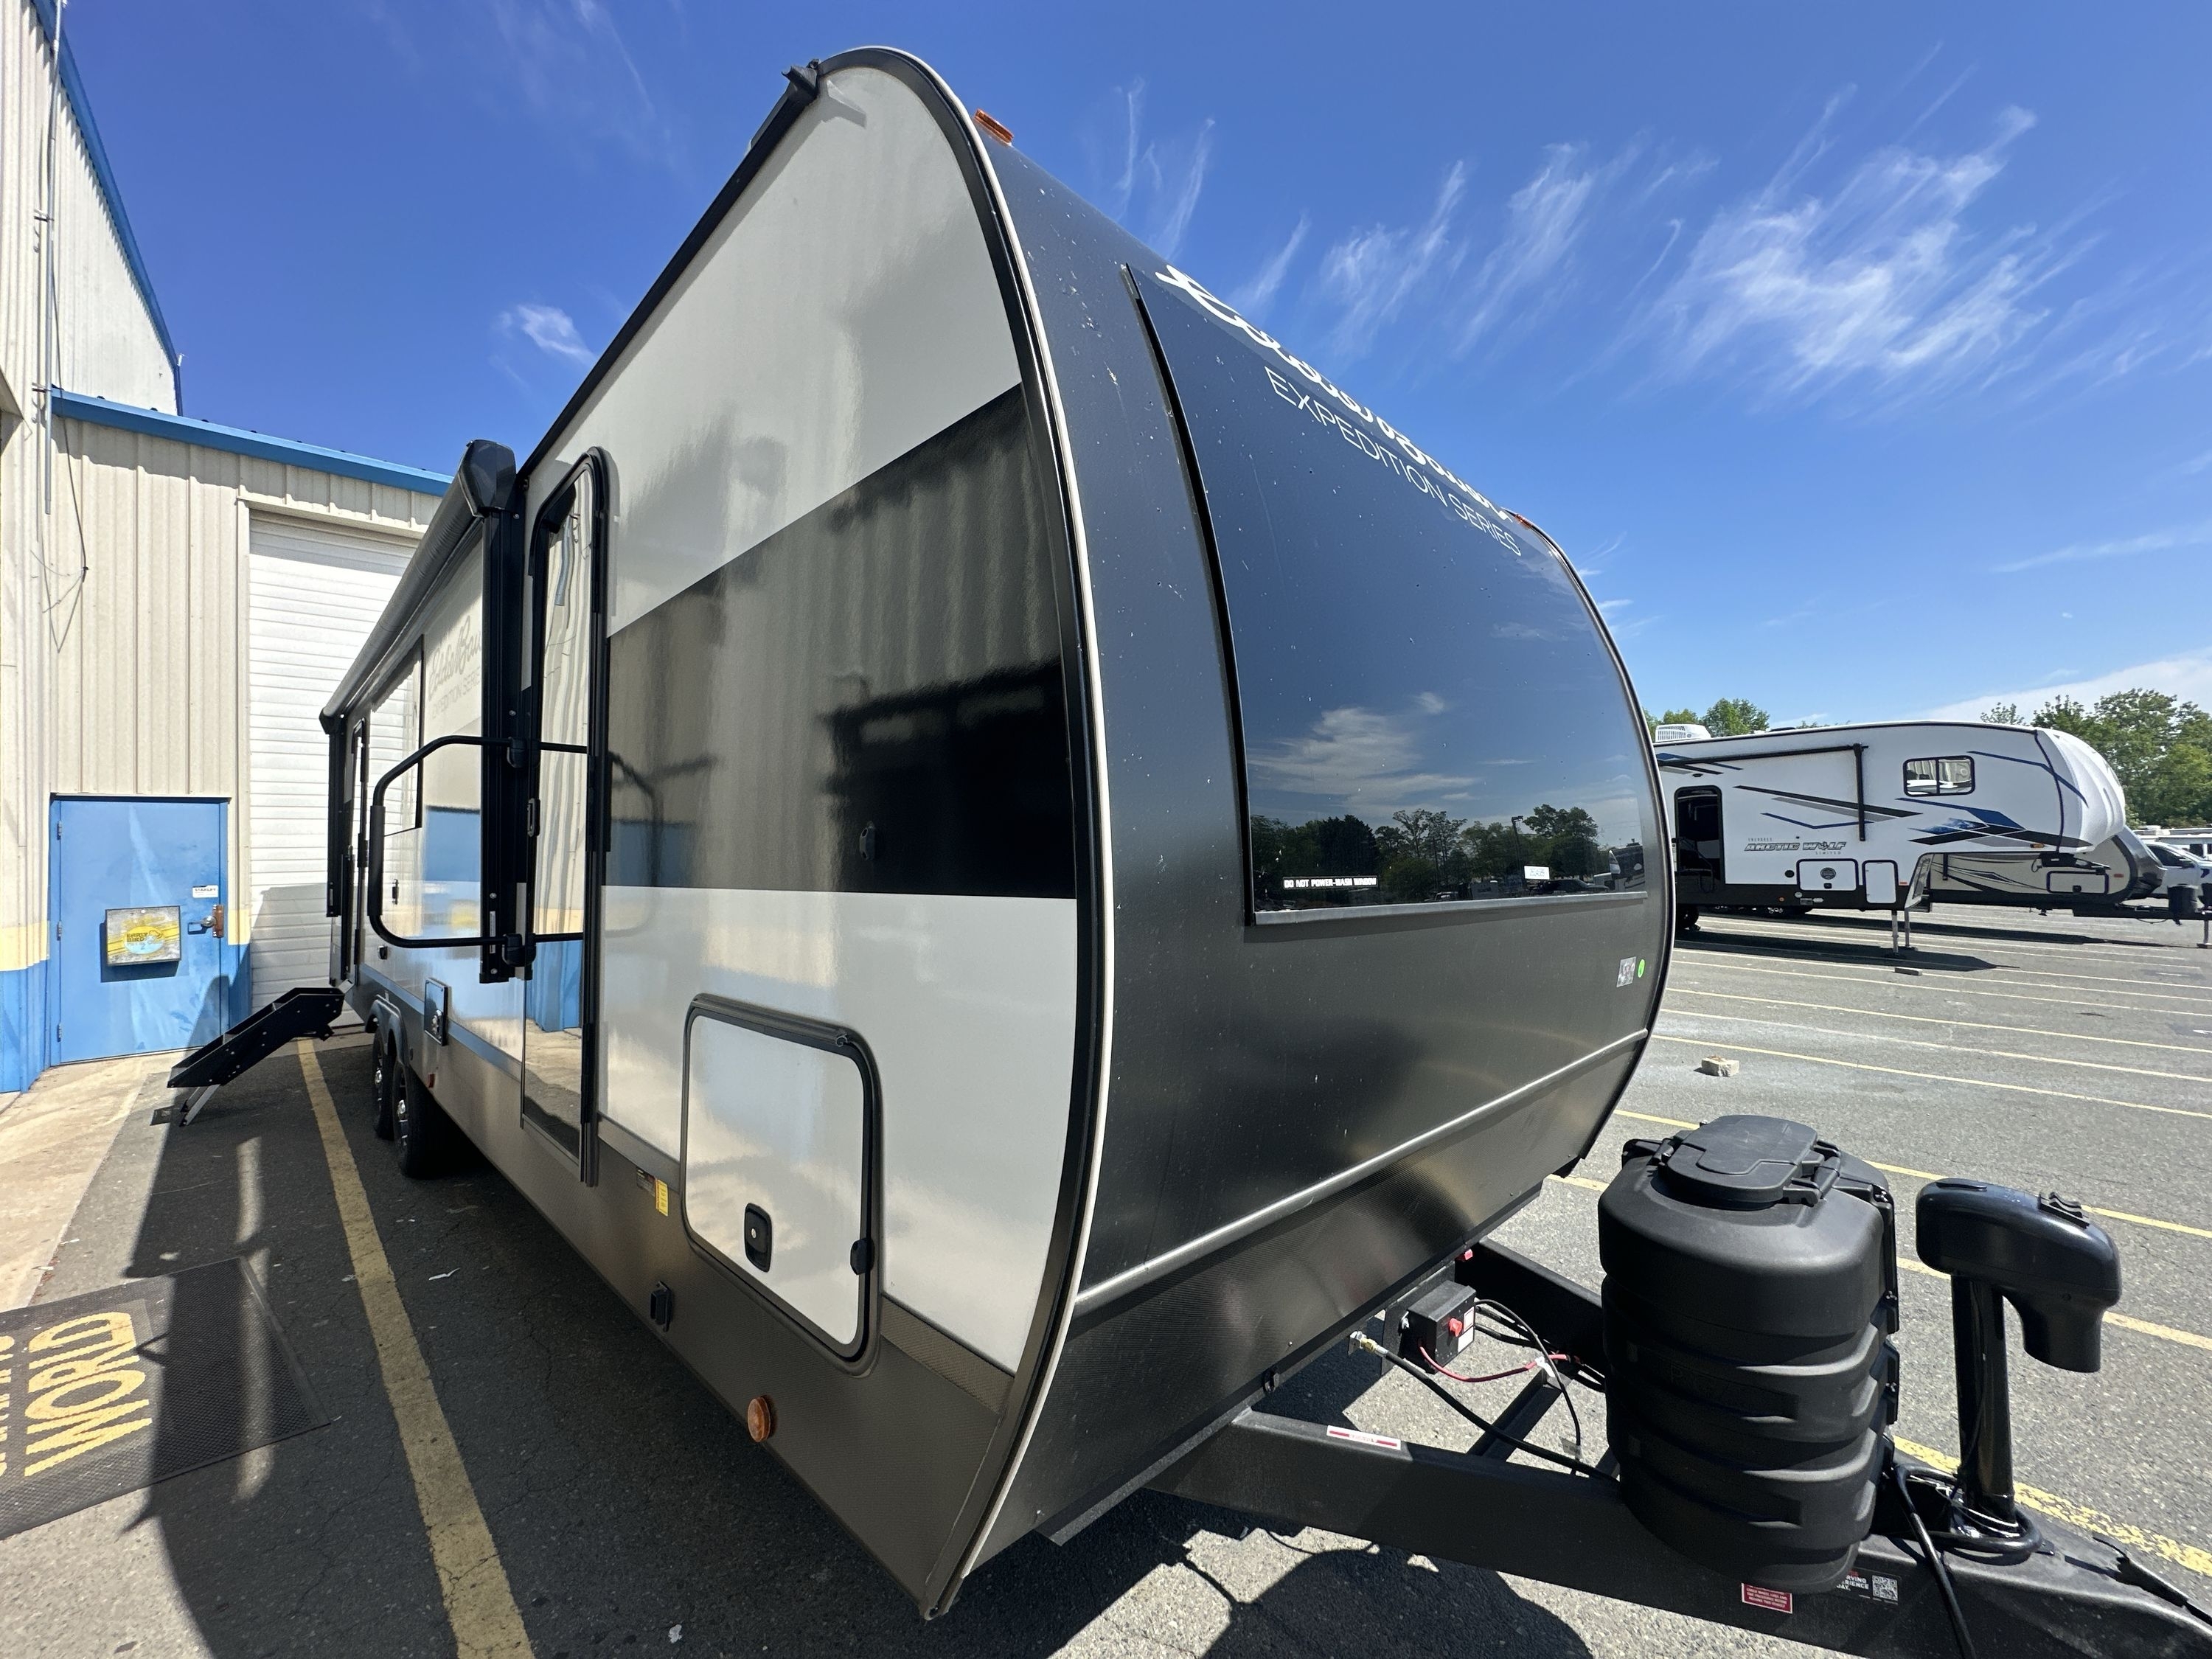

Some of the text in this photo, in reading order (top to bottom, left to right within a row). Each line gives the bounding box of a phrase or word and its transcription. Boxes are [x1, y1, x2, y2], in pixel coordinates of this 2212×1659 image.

[1263, 366, 1522, 557] EXPEDITION SERIES
[1284, 880, 1294, 888] DO
[1295, 879, 1310, 887] NOT
[1353, 877, 1377, 886] WINDOW
[1744, 843, 1801, 852] ARCTIC
[24, 1312, 153, 1477] WORLD
